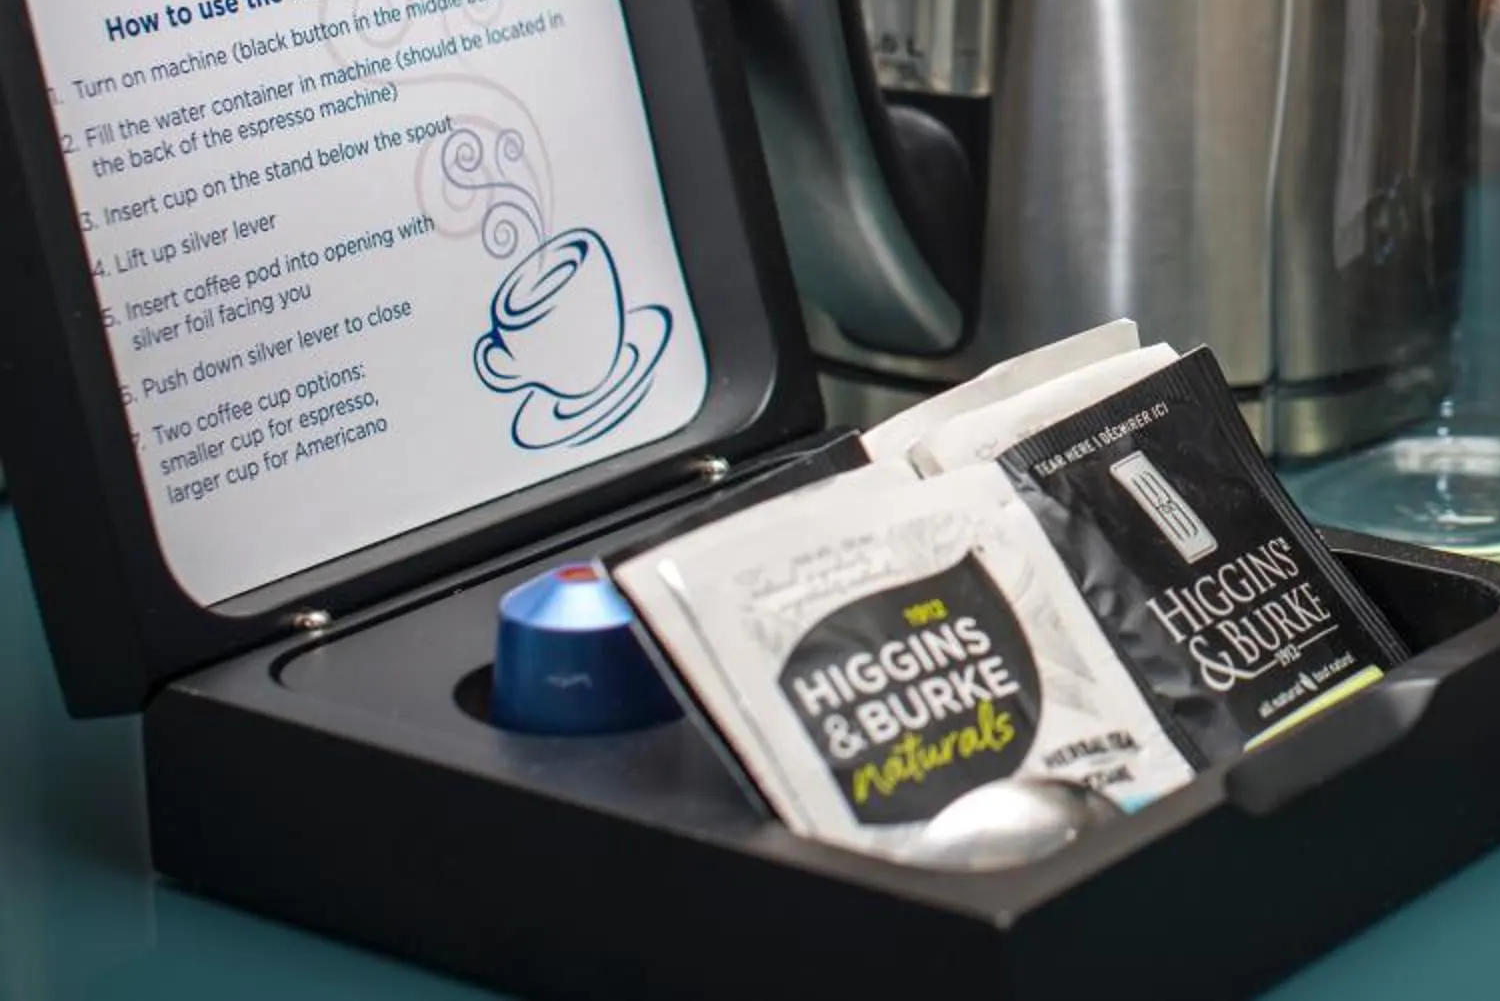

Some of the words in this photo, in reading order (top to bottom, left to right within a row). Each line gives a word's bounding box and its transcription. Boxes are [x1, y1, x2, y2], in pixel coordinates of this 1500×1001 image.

[72, 77, 117, 100] Turn
[122, 68, 146, 88] on
[150, 50, 227, 81] machine
[232, 32, 288, 64] (black
[291, 17, 350, 47] button
[352, 14, 370, 32] in
[374, 5, 401, 26] the
[104, 13, 159, 41] How
[166, 4, 192, 26] to
[84, 123, 115, 148] Fill
[119, 117, 150, 141] the
[154, 102, 206, 130] water
[211, 80, 295, 116] container
[299, 74, 317, 96] in
[320, 55, 392, 89] machine
[396, 36, 458, 71] (should
[460, 32, 483, 52] be
[486, 15, 546, 45] located
[547, 10, 565, 30] in
[92, 155, 125, 178] the
[129, 141, 176, 168] back
[179, 133, 202, 155] of
[203, 128, 233, 149] the
[238, 105, 315, 140] espresso
[319, 82, 399, 118] machine)
[103, 197, 159, 226] Insert
[163, 187, 198, 210] cup
[202, 178, 227, 198] on
[230, 169, 260, 191] the
[265, 151, 313, 182] stand
[317, 140, 369, 168] below
[373, 130, 403, 152] the
[405, 114, 453, 145] spout
[115, 248, 148, 274] Lift
[152, 242, 177, 263] up
[181, 226, 229, 253] silver
[232, 212, 276, 239] lever
[125, 292, 179, 320] Insert
[183, 273, 240, 304] coffee
[245, 261, 281, 288] pod
[285, 249, 319, 273] into
[324, 227, 394, 264] opening
[397, 214, 435, 240] with
[132, 322, 179, 350] silver
[185, 309, 214, 333] foil
[219, 293, 273, 327] facing
[278, 283, 311, 309] you
[141, 368, 188, 398] Push
[192, 353, 243, 383] down
[247, 337, 294, 366] silver
[297, 326, 340, 349] lever
[344, 315, 363, 335] to
[367, 300, 412, 328] close
[152, 421, 193, 445] Two
[197, 400, 253, 432] coffee
[257, 387, 291, 411] cup
[295, 362, 366, 399] options:
[160, 439, 225, 476] smaller
[230, 428, 265, 451] cup
[268, 416, 294, 439] for
[299, 390, 380, 429] espresso,
[1033, 454, 1067, 478] TEAR
[1064, 439, 1096, 463] HERE
[1151, 401, 1169, 419] ICI
[167, 473, 221, 504] larger
[226, 460, 260, 485] cup
[263, 448, 289, 472] for
[295, 416, 388, 461] Americano
[793, 616, 992, 717] HIGGINS
[853, 696, 1015, 804] naturals
